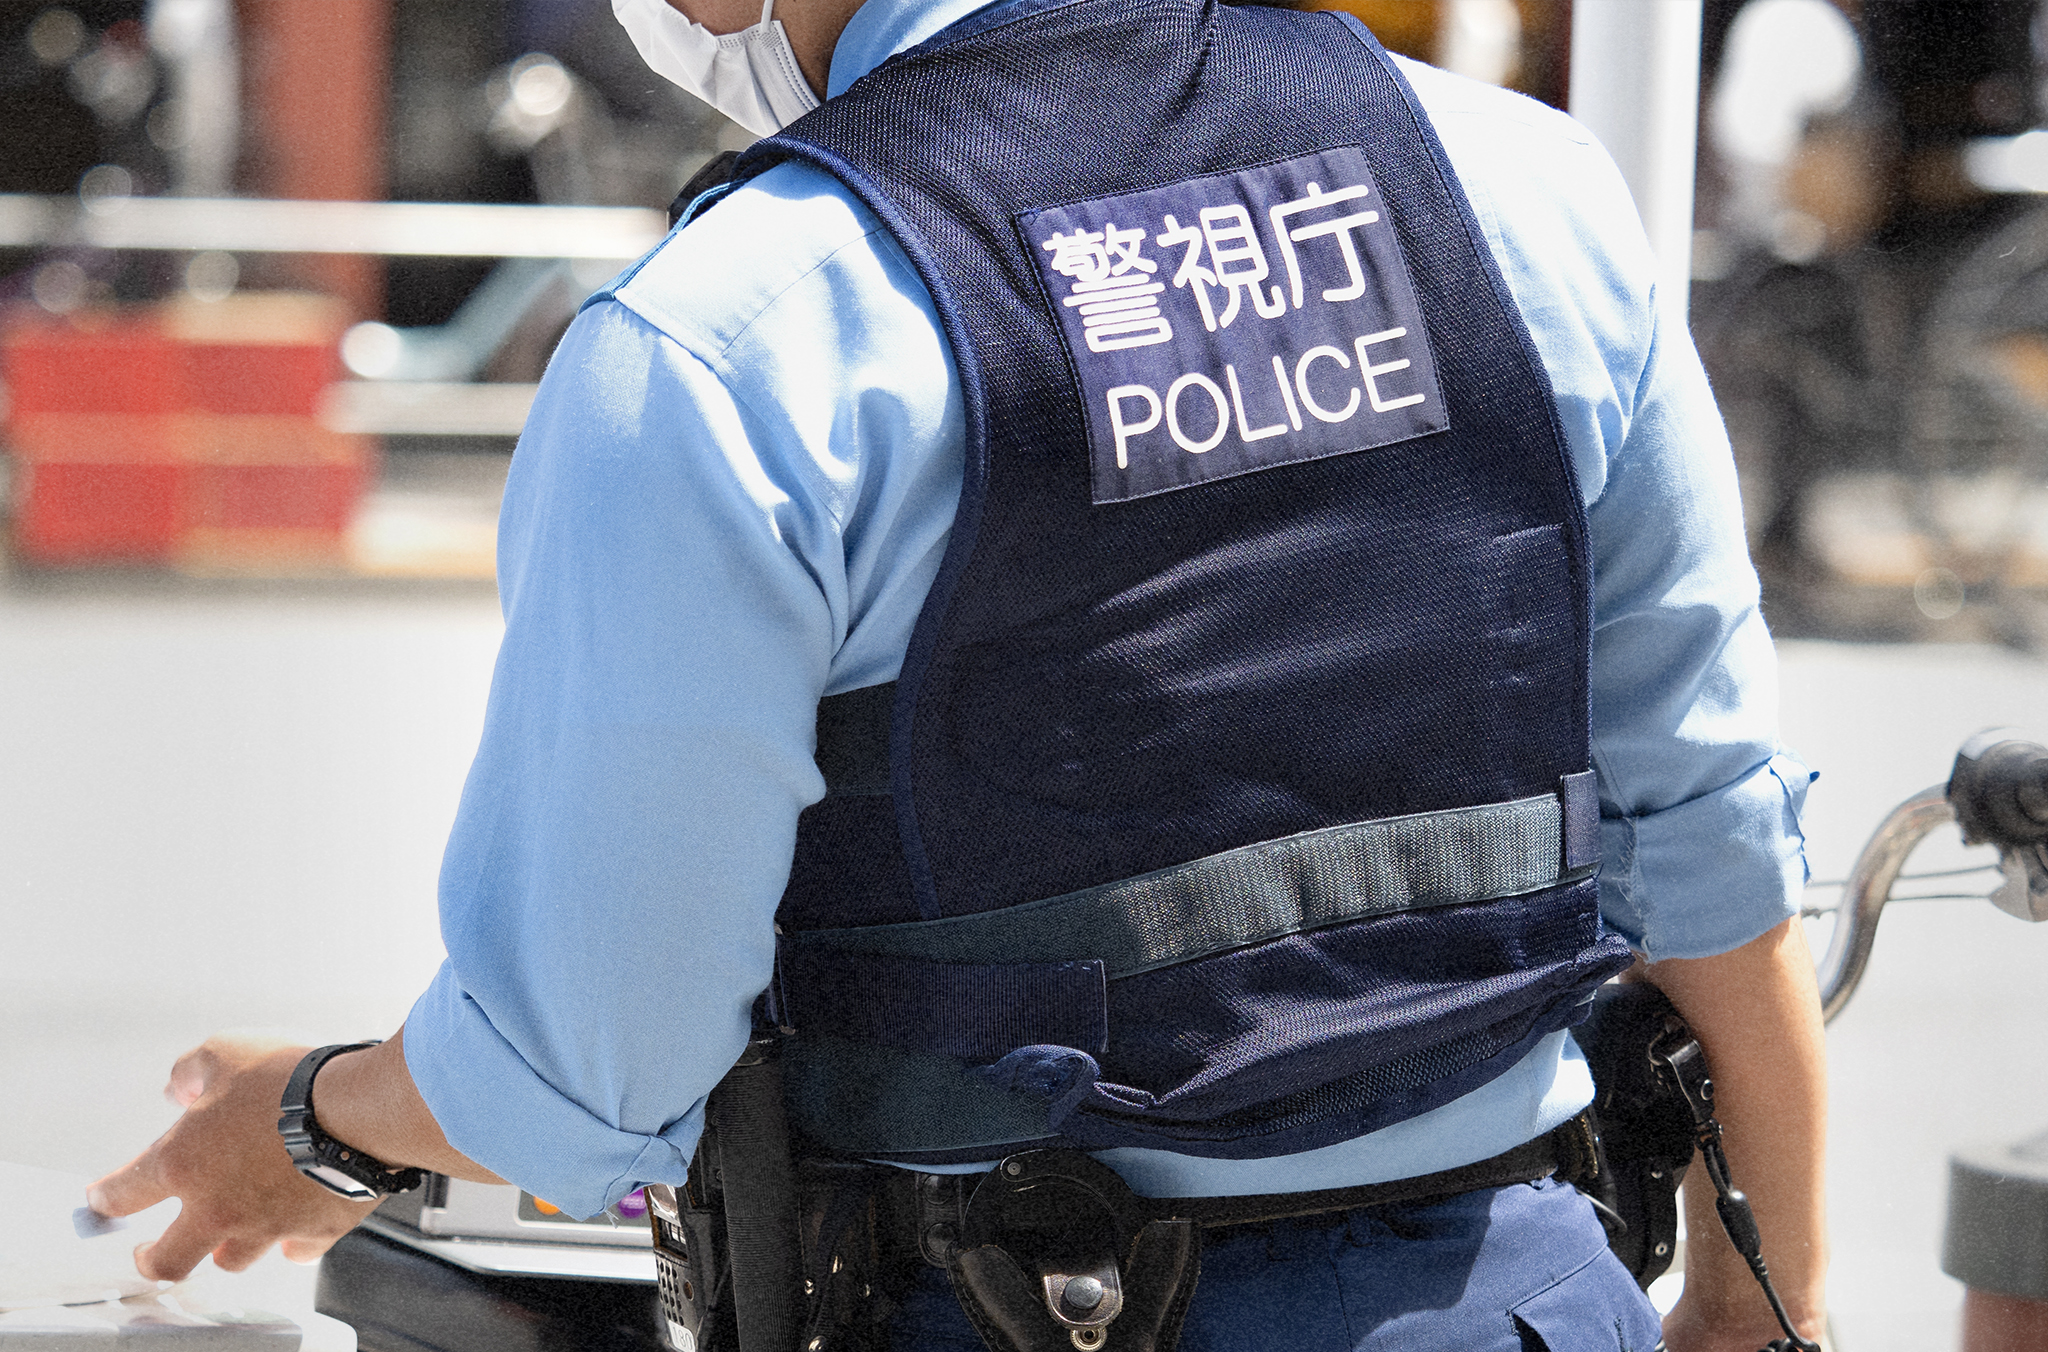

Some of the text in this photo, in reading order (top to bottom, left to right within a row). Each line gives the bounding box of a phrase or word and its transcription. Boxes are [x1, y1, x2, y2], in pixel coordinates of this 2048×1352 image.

[1043, 182, 1379, 352] 警視庁
[1107, 326, 1426, 468] POLICE
